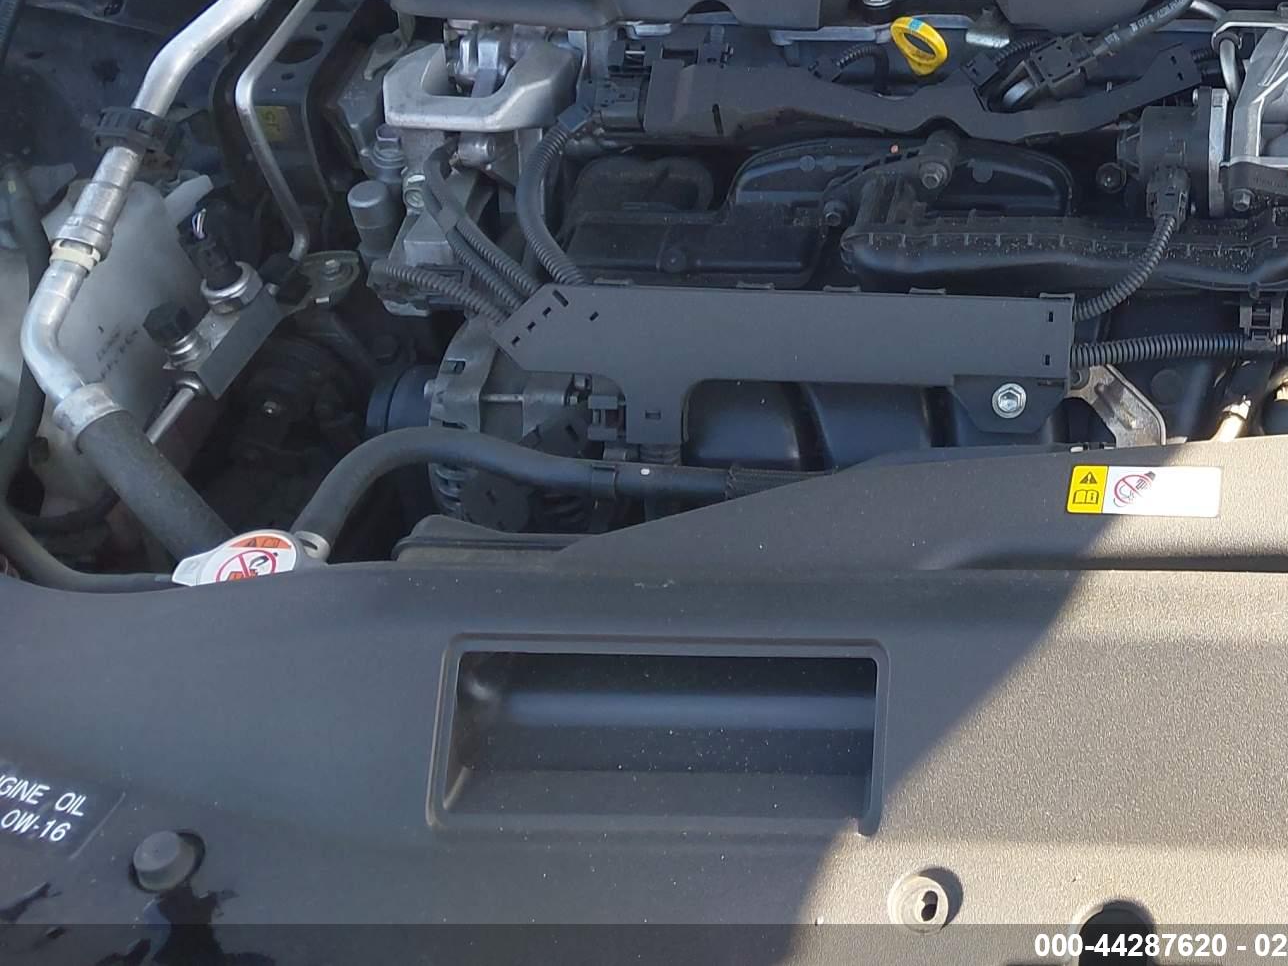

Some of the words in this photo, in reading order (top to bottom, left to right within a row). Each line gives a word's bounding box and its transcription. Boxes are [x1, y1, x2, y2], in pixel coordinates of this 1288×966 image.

[0, 775, 51, 805] GINE
[54, 791, 87, 817] OIL
[0, 809, 72, 842] 0W-16
